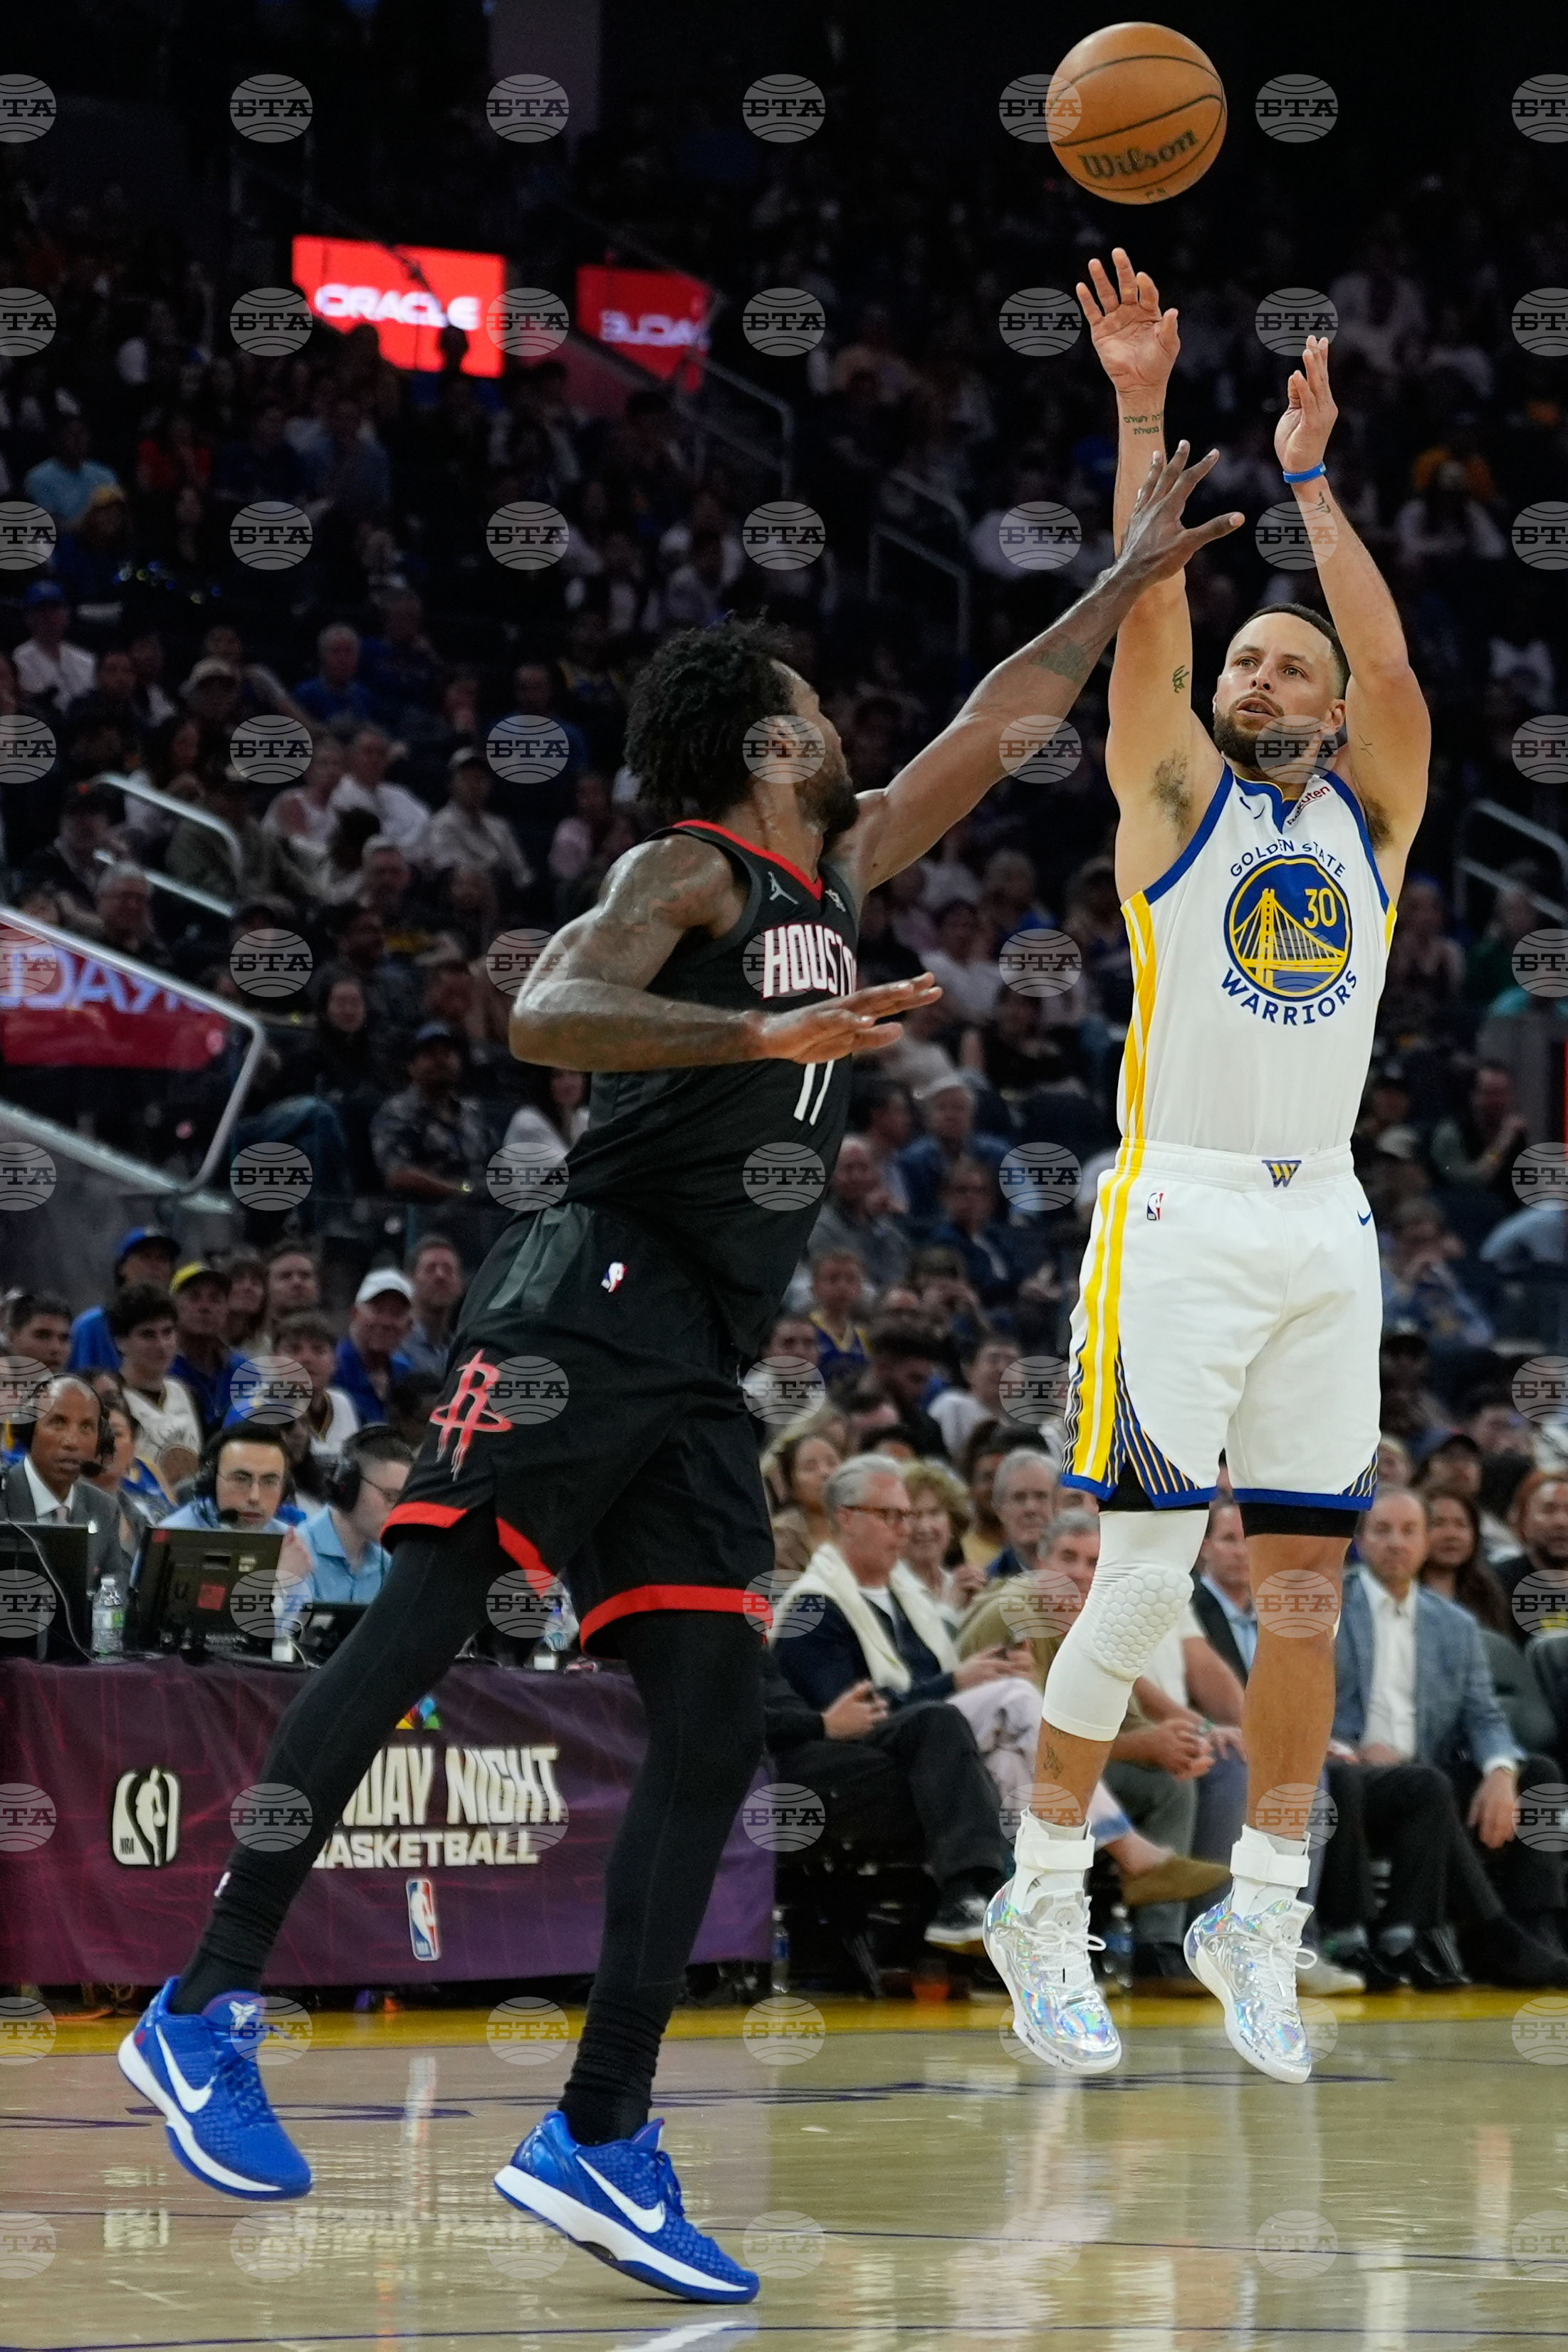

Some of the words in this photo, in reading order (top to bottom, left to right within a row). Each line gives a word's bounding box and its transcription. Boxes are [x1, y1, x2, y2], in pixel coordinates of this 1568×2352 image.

[1079, 130, 1198, 178] Wilson
[314, 283, 481, 330] ORACLE
[1230, 839, 1295, 877] GOLDEN
[1302, 842, 1345, 877] STATE
[1303, 888, 1337, 929] 30
[1221, 967, 1357, 1025] WARRIORS
[343, 1747, 433, 1826] DAY
[446, 1747, 559, 1824] NIGHT
